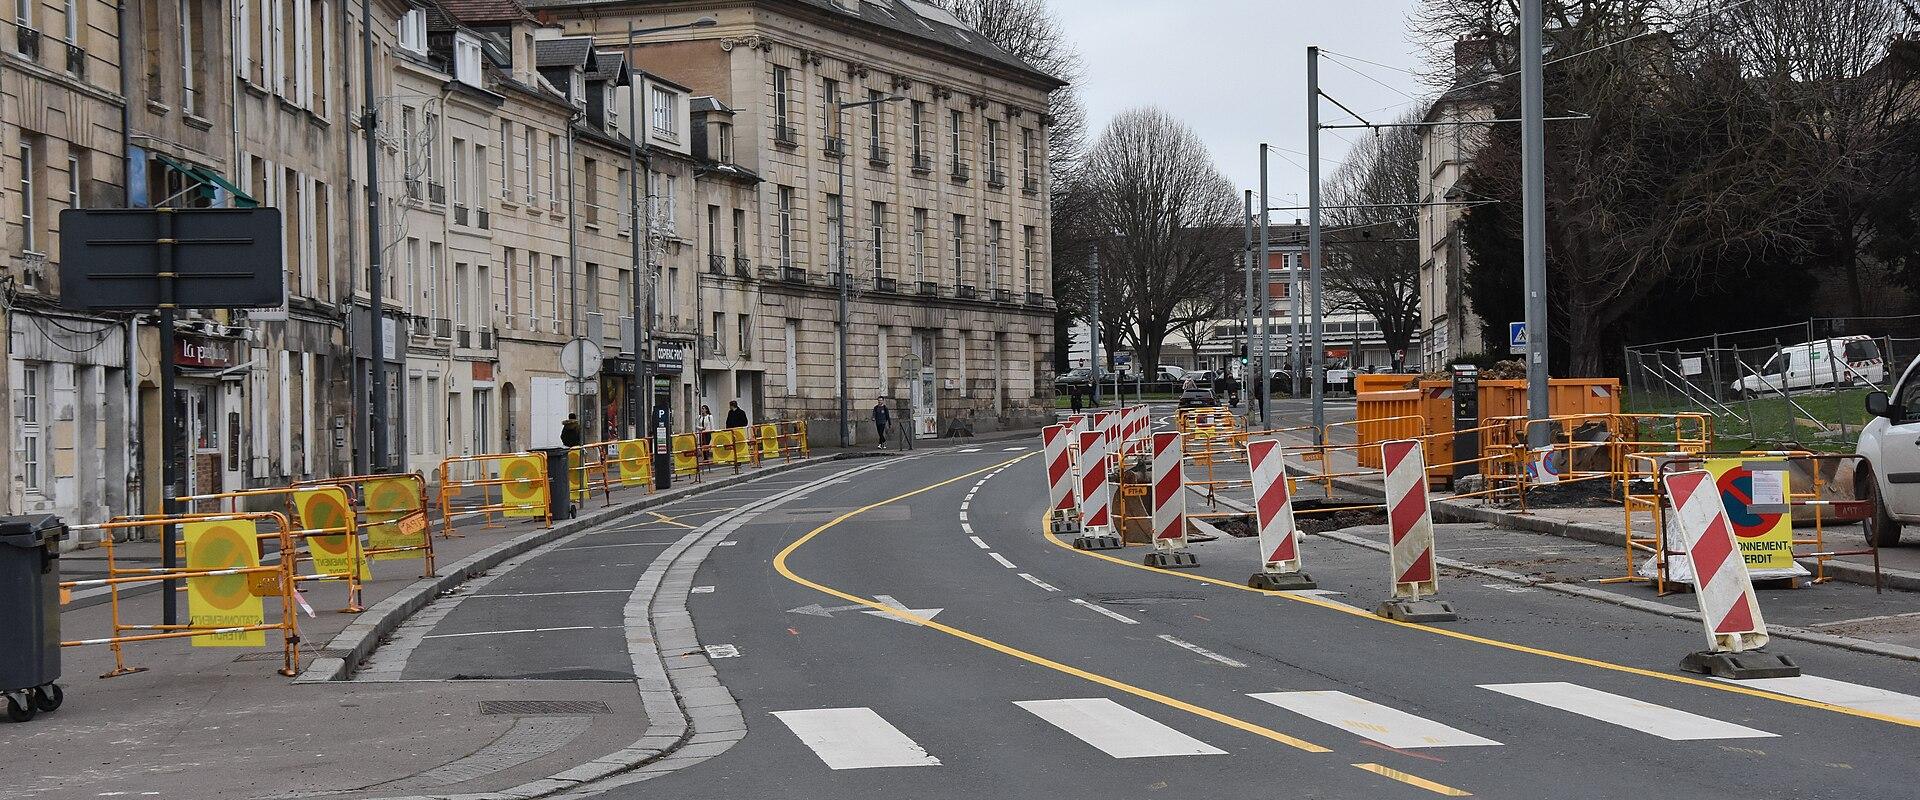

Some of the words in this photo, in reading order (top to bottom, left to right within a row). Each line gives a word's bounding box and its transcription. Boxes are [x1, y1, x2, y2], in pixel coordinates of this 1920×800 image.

[183, 340, 195, 358] la
[659, 409, 665, 419] P
[1738, 541, 1788, 551] ONNEMENT
[1743, 554, 1773, 564] ERDIT
